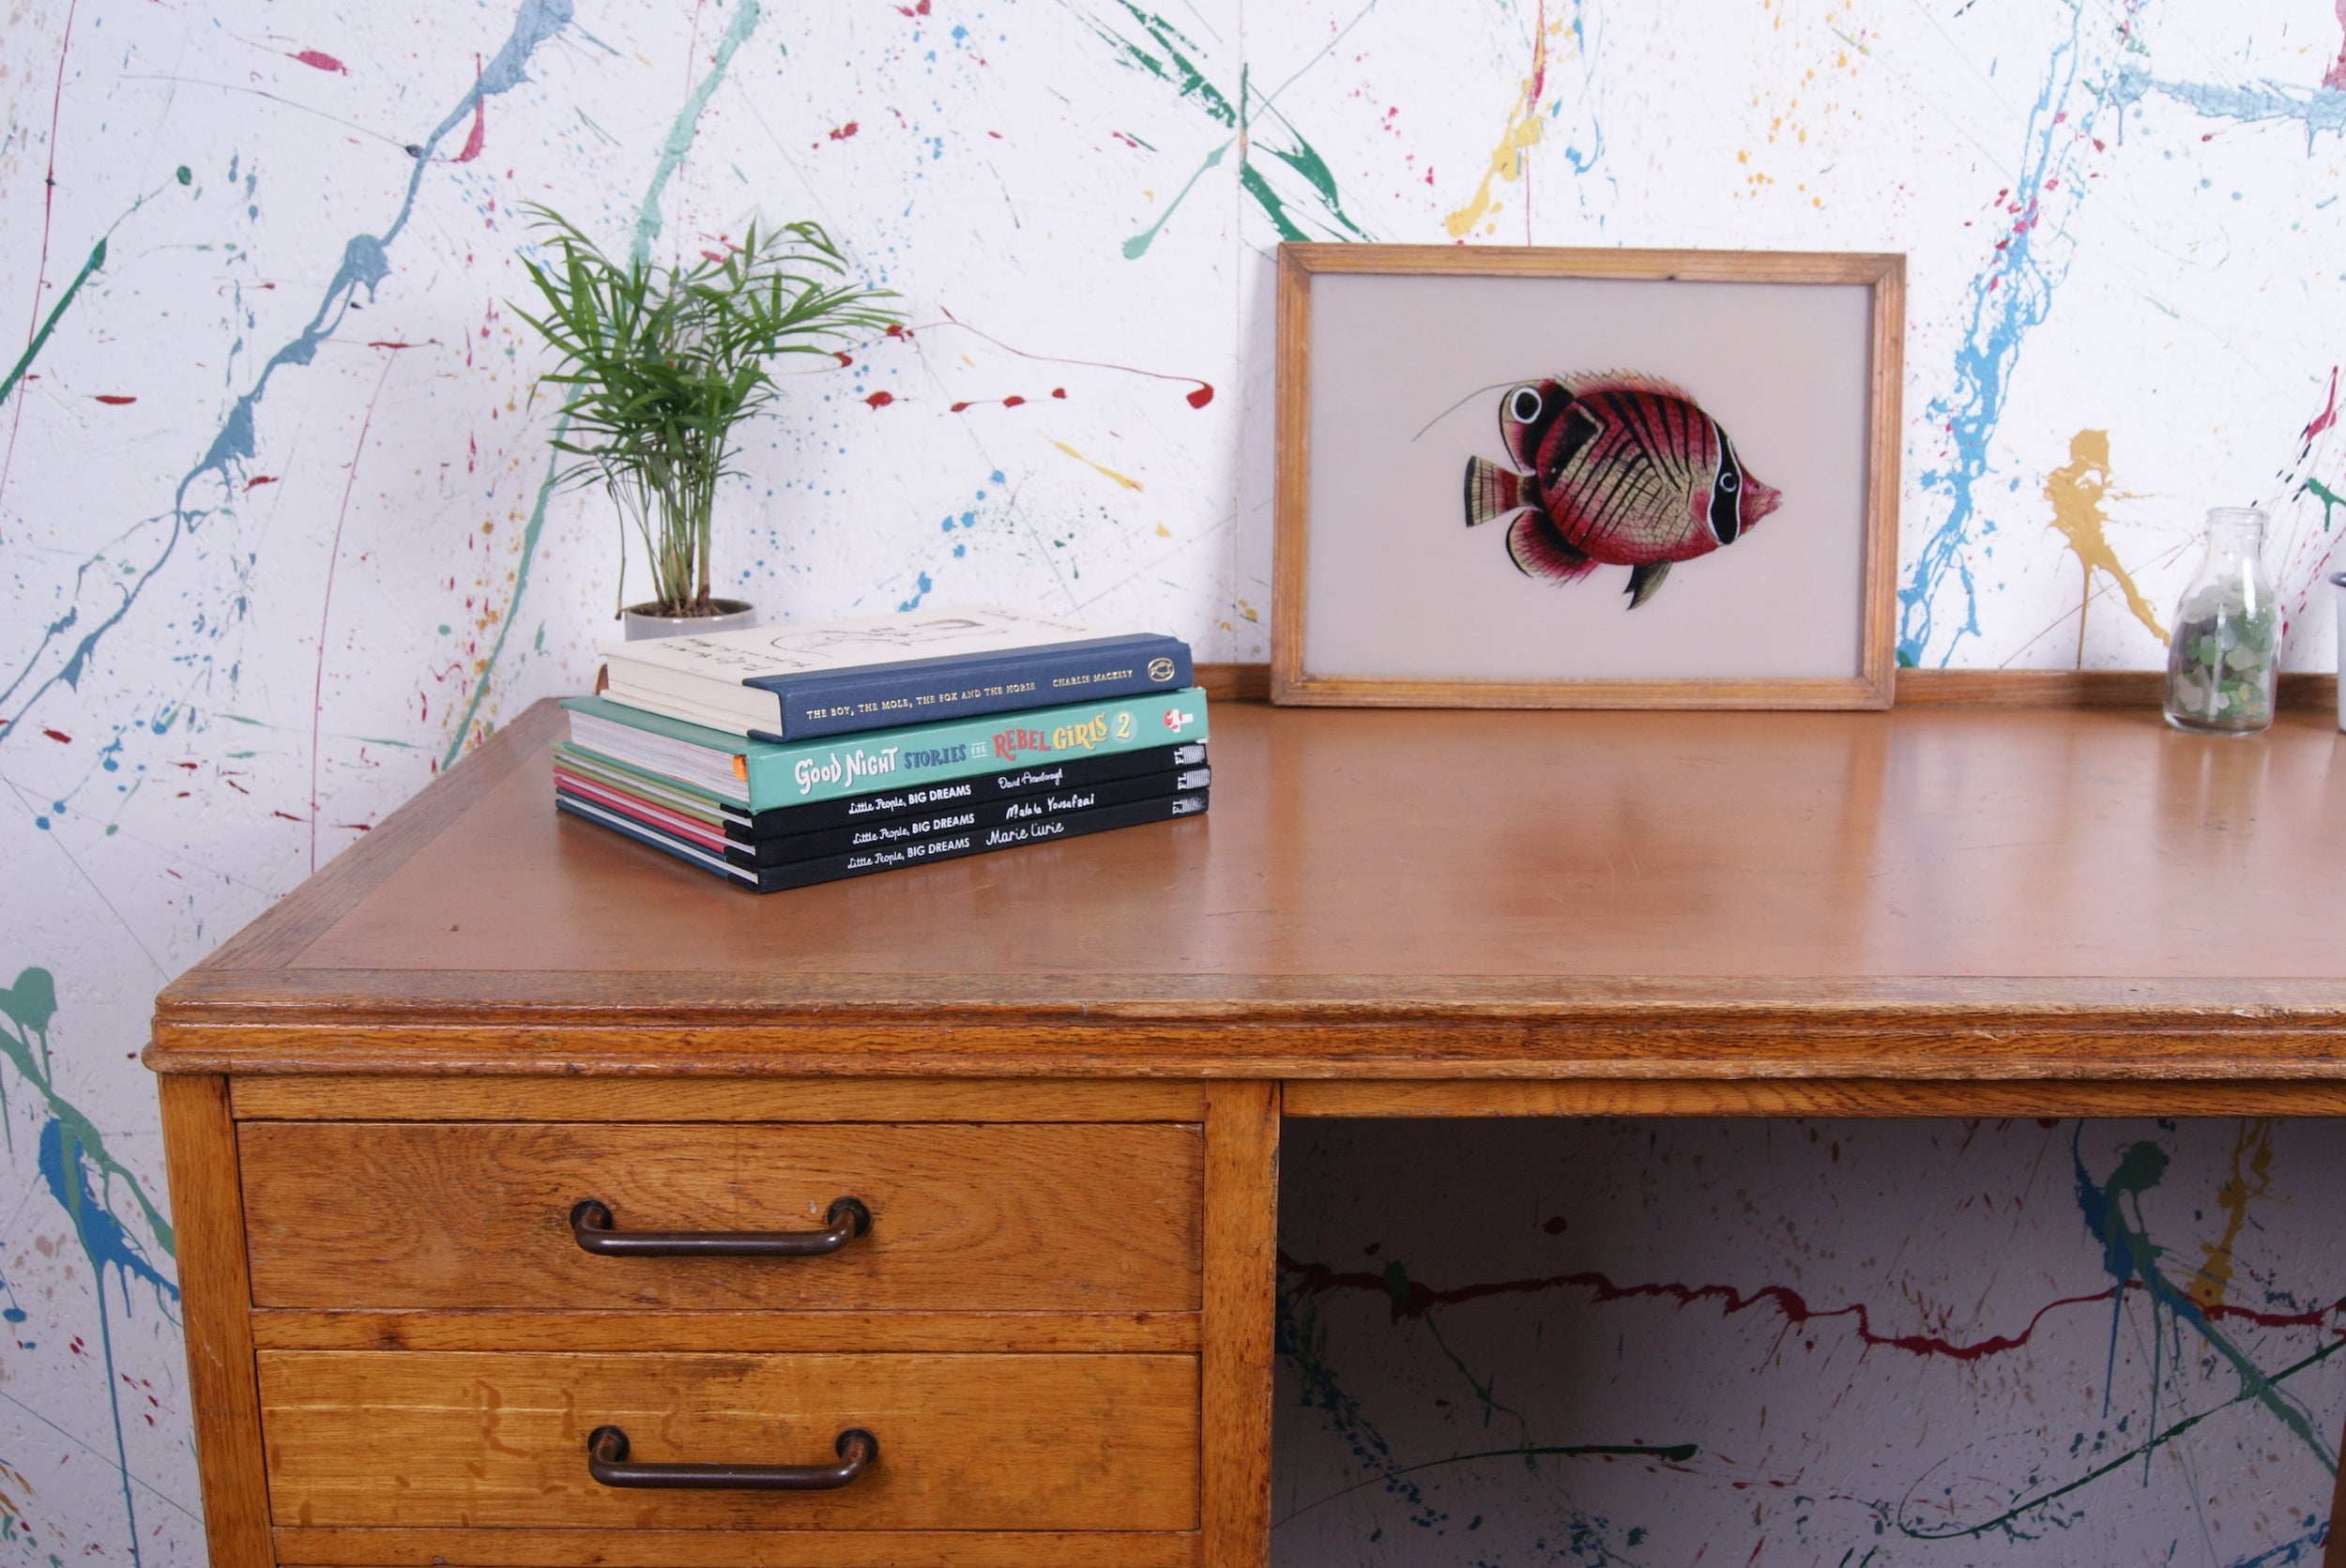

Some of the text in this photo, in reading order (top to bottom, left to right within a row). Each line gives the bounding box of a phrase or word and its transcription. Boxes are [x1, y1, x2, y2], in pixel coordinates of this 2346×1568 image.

[1053, 675, 1090, 688] CHARLIE
[806, 681, 1036, 720] THE BOY, THE MOLE, THE FOX AND THE HORSE
[904, 744, 967, 769] STORIES
[992, 728, 1051, 761] REBEL
[1052, 713, 1107, 751] GIRLS
[1117, 711, 1131, 739] 2
[998, 777, 1021, 789] David
[848, 784, 971, 814] Little People, BIG DREAMS
[1005, 793, 1095, 819] Malala Yousafzai
[853, 813, 975, 845] Little People, BIG DREAMS
[986, 822, 1064, 845] Marie Curie
[847, 837, 970, 869] Little People, BIG DREAMS
